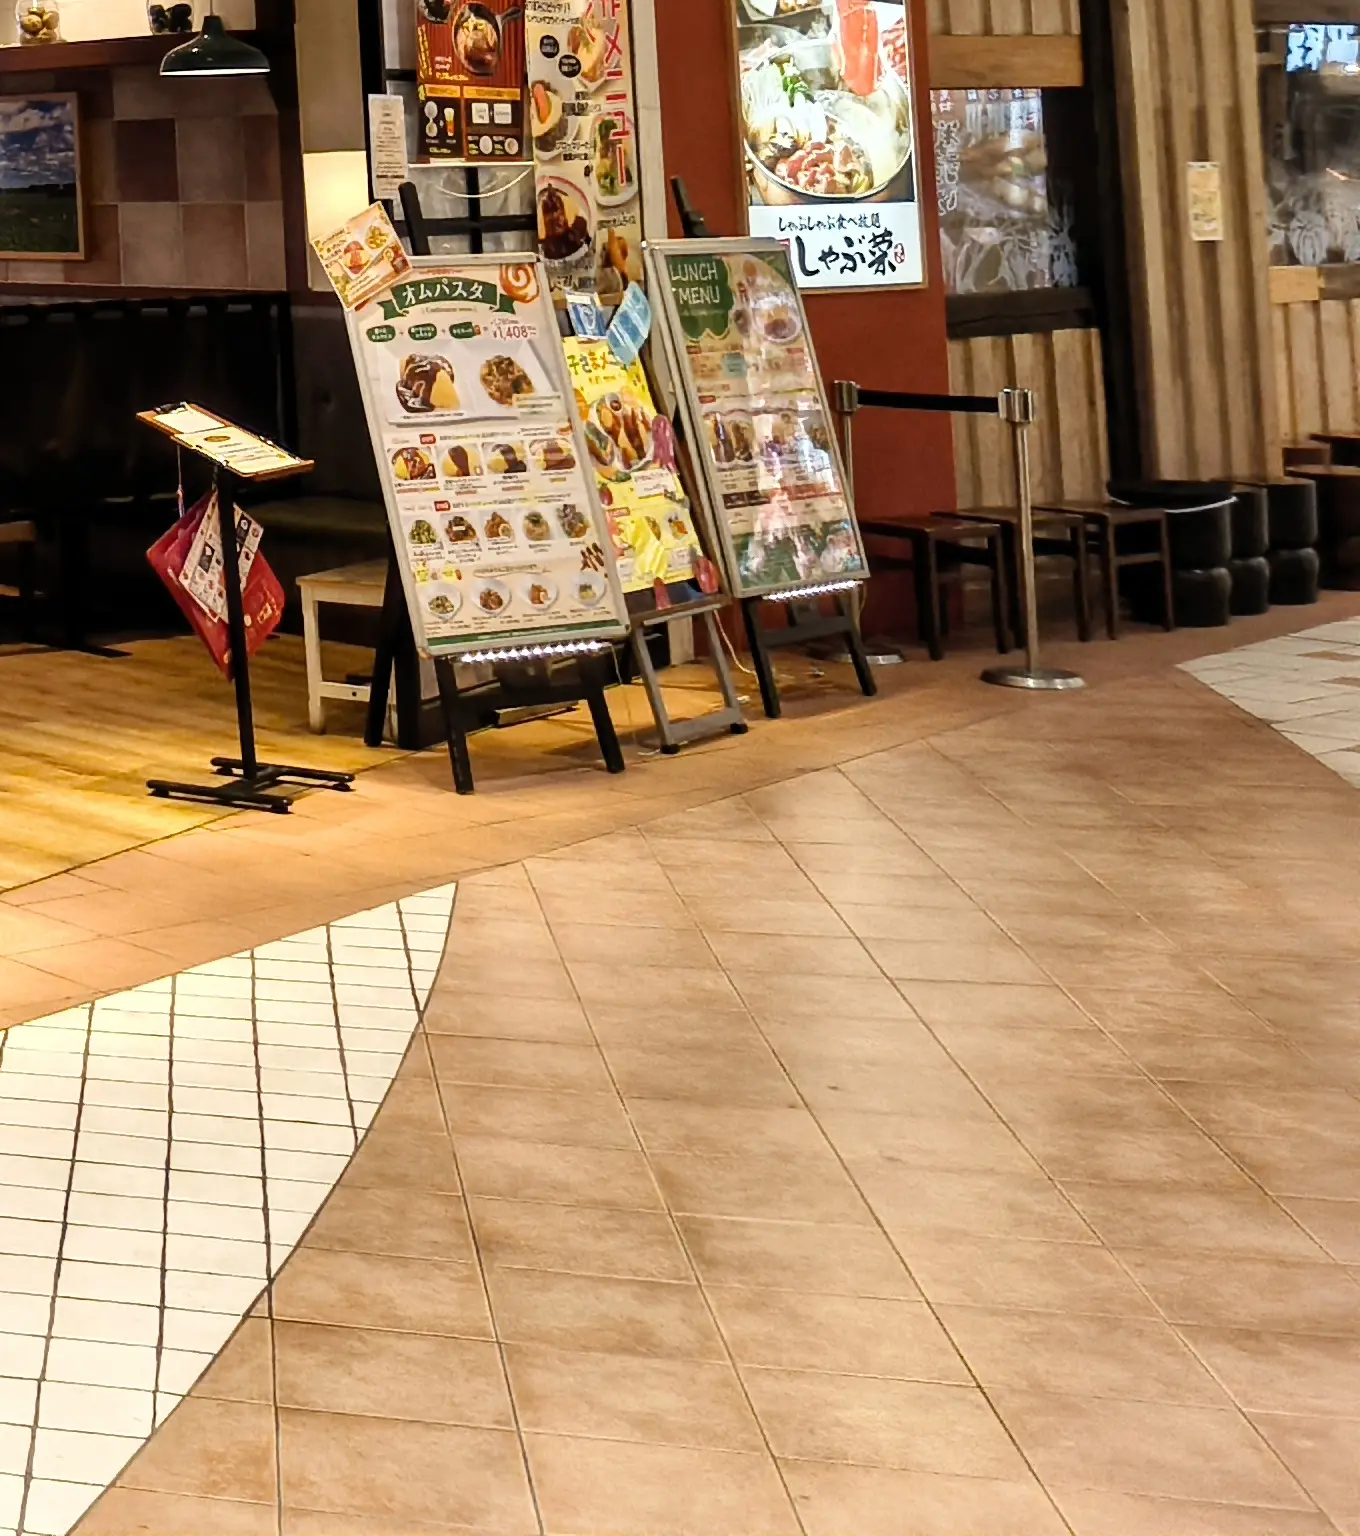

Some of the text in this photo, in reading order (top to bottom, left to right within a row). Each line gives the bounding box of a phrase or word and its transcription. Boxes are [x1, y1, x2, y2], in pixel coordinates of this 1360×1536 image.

[778, 212, 882, 232] しゃぶしゃぶ食べ放題
[794, 227, 897, 277] しゃぶ菜
[670, 261, 719, 282] LUNCH
[401, 277, 484, 306] オムパスタ
[679, 285, 721, 305] MENU
